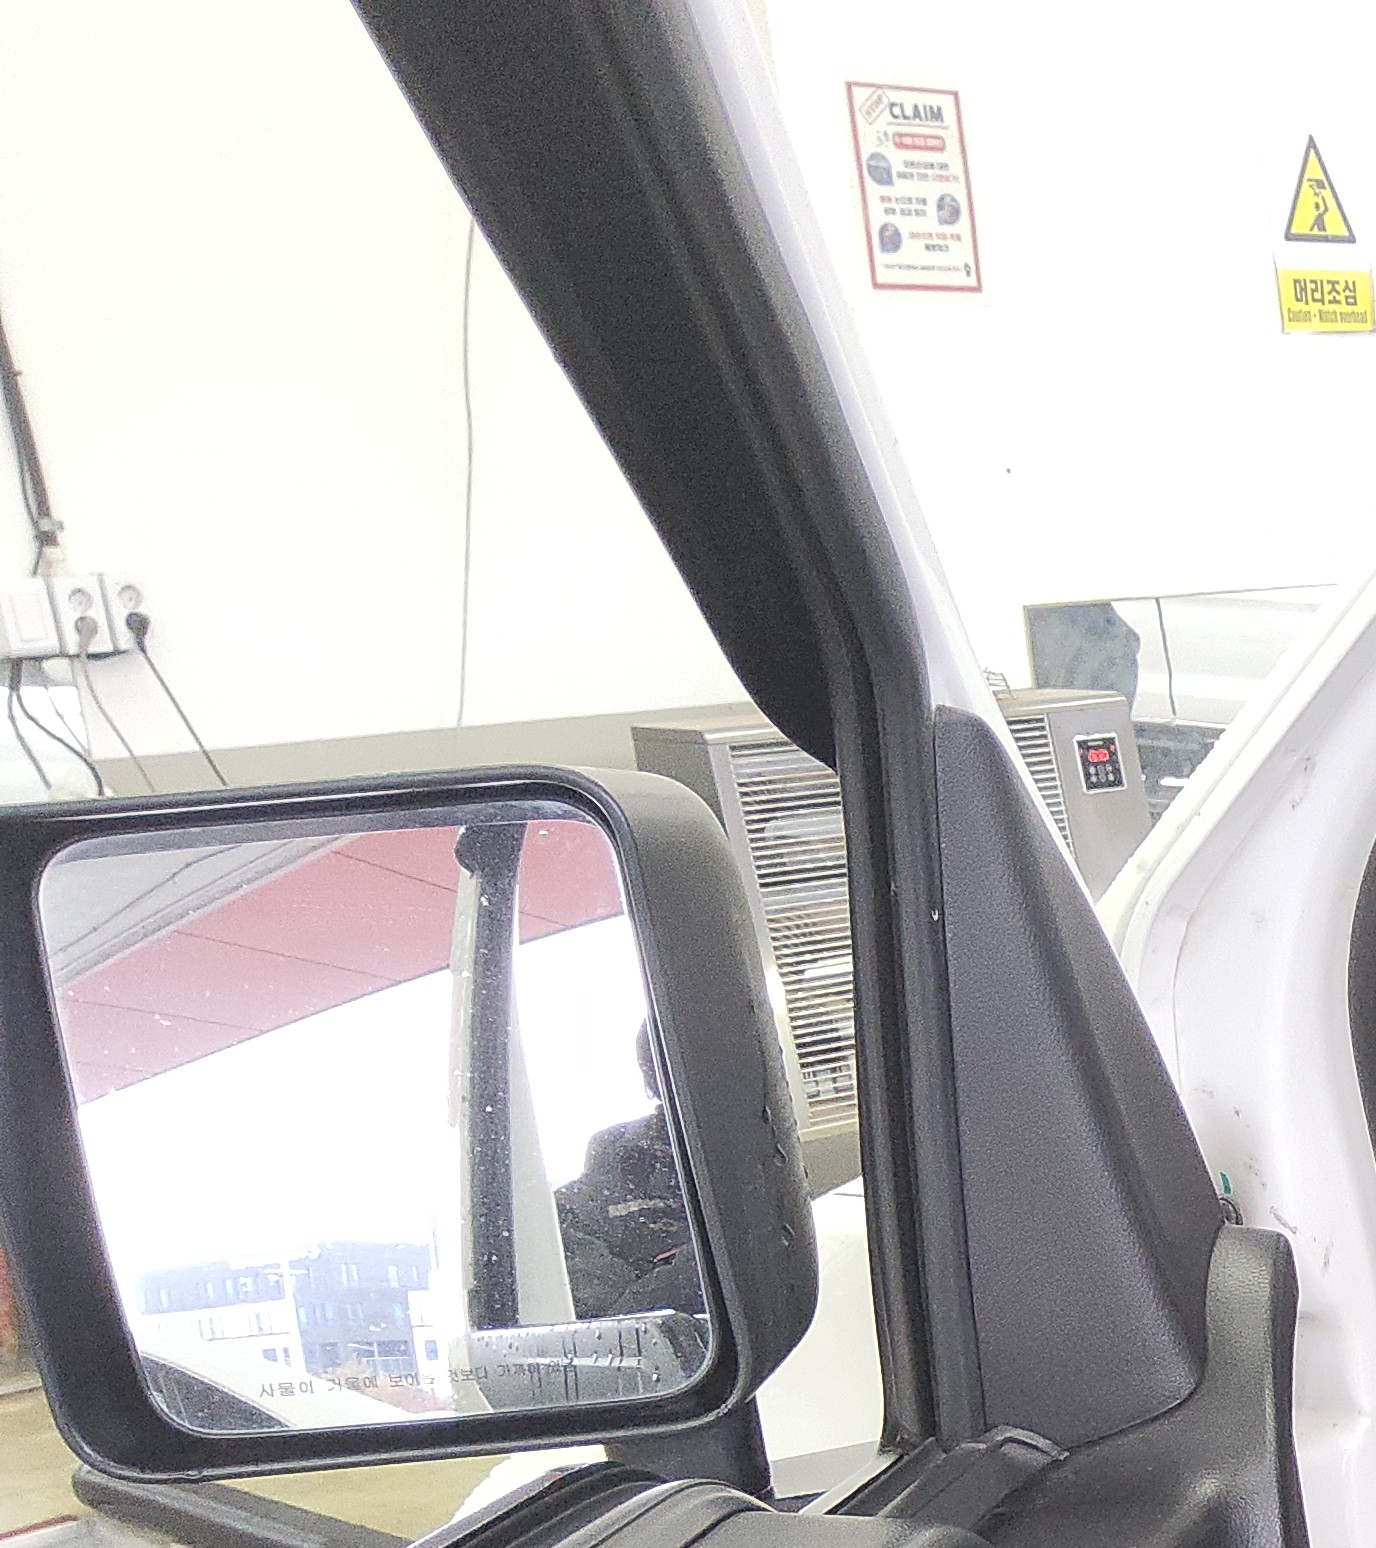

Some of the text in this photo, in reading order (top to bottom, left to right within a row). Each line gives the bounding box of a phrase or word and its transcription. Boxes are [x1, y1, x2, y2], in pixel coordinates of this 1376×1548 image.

[889, 101, 944, 122] CLAIM
[1293, 278, 1358, 306] 머리조심
[1287, 308, 1312, 323] Caution
[259, 1380, 314, 1398] 사물이
[327, 1375, 379, 1392] 거울에
[388, 1372, 436, 1393] 보이는
